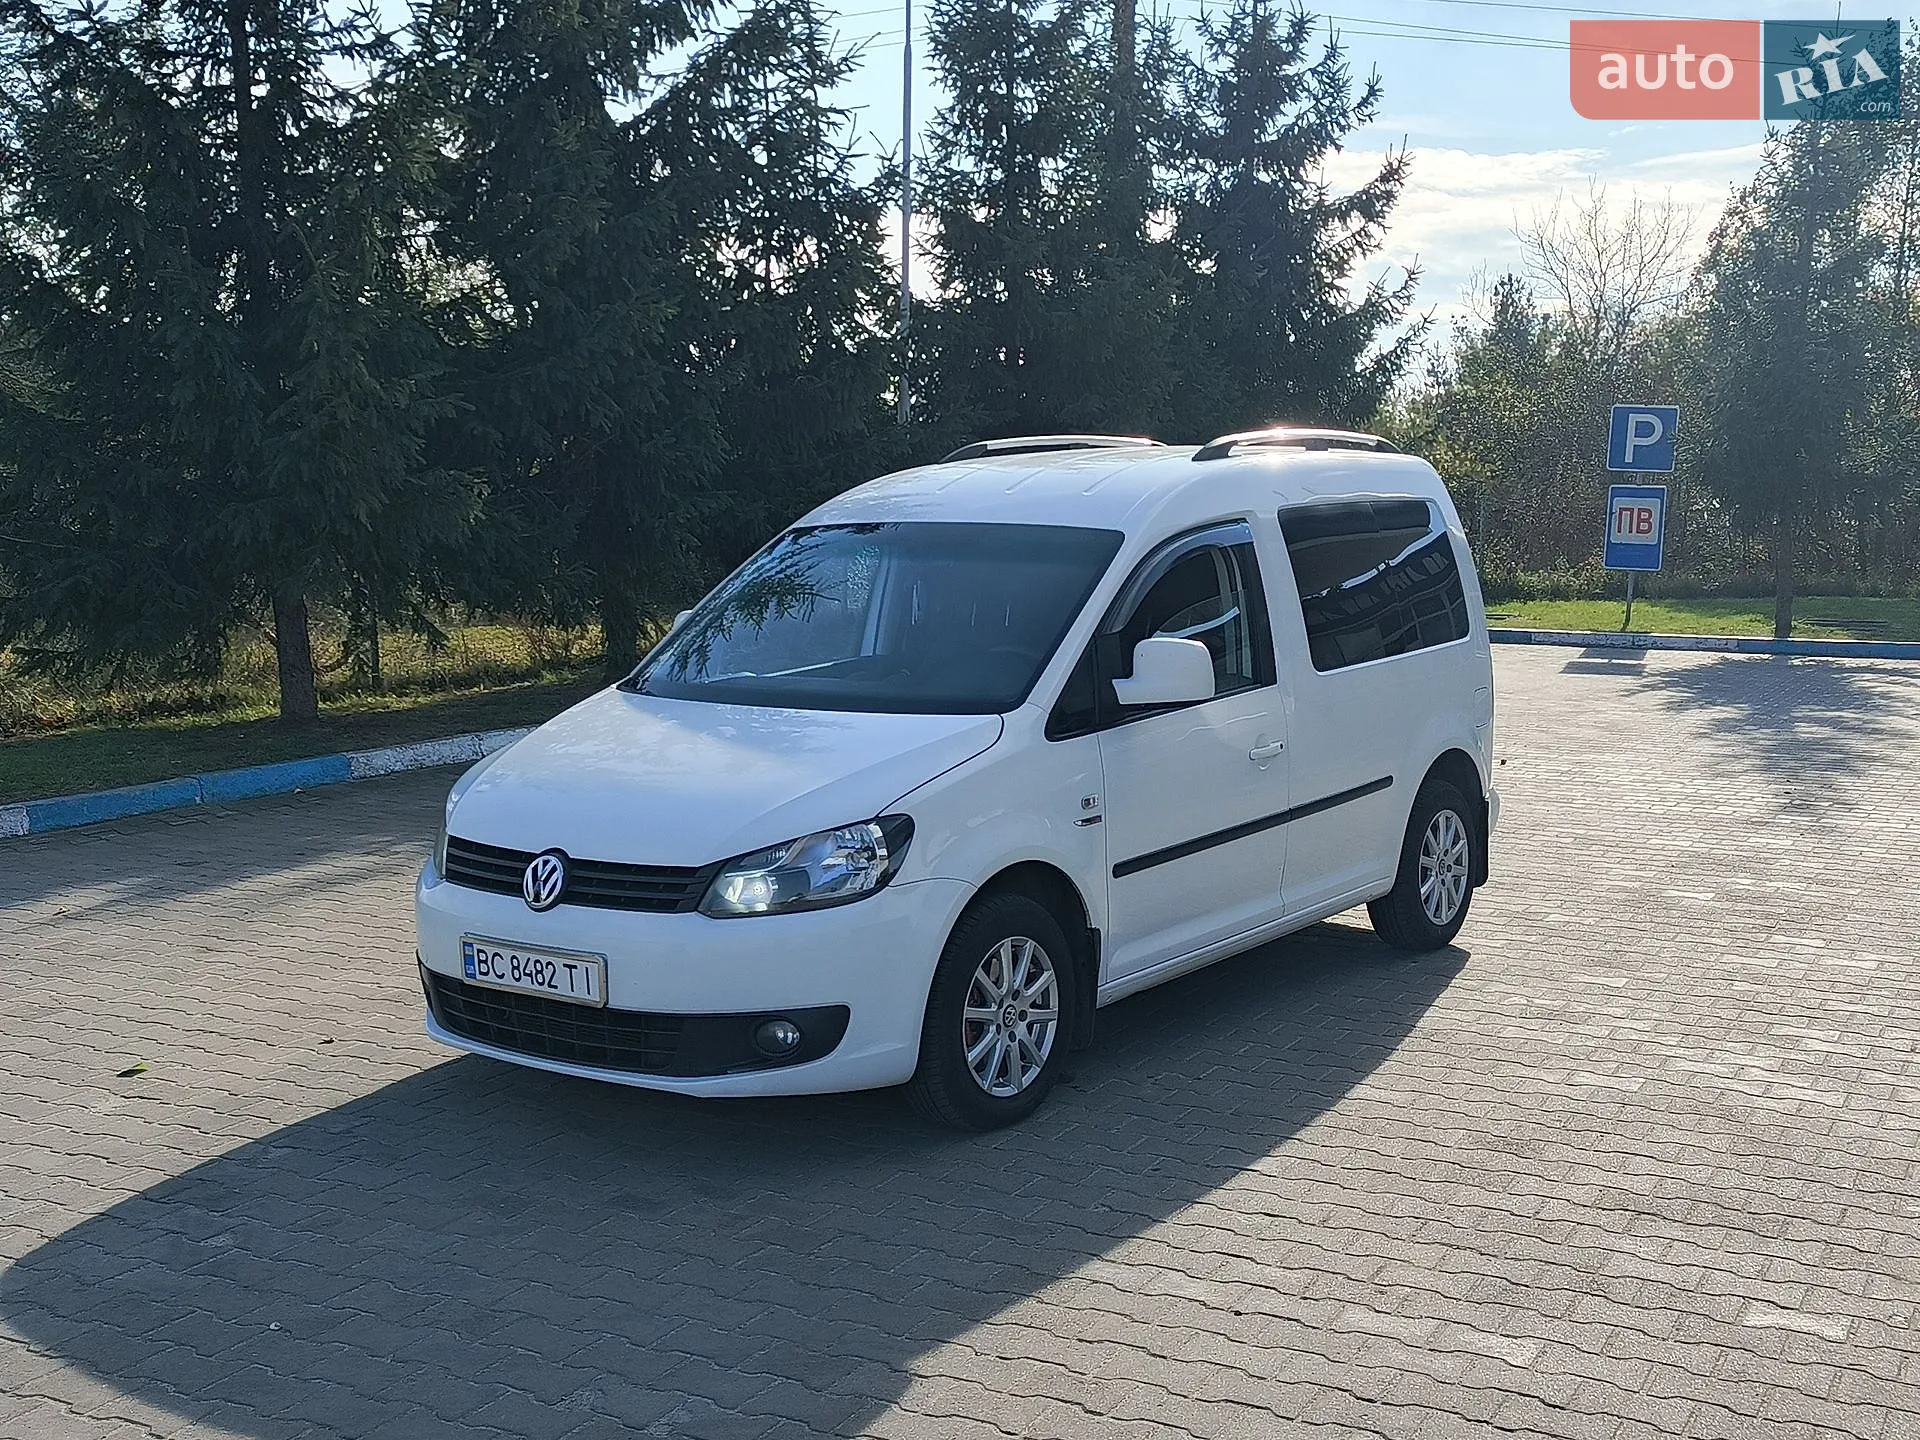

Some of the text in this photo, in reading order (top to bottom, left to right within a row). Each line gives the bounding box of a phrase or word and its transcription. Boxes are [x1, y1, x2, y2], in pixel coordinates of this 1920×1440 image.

[1625, 413, 1663, 463] P
[1617, 507, 1654, 535] ПВ
[476, 948, 505, 979] BC
[510, 954, 558, 989] 8482
